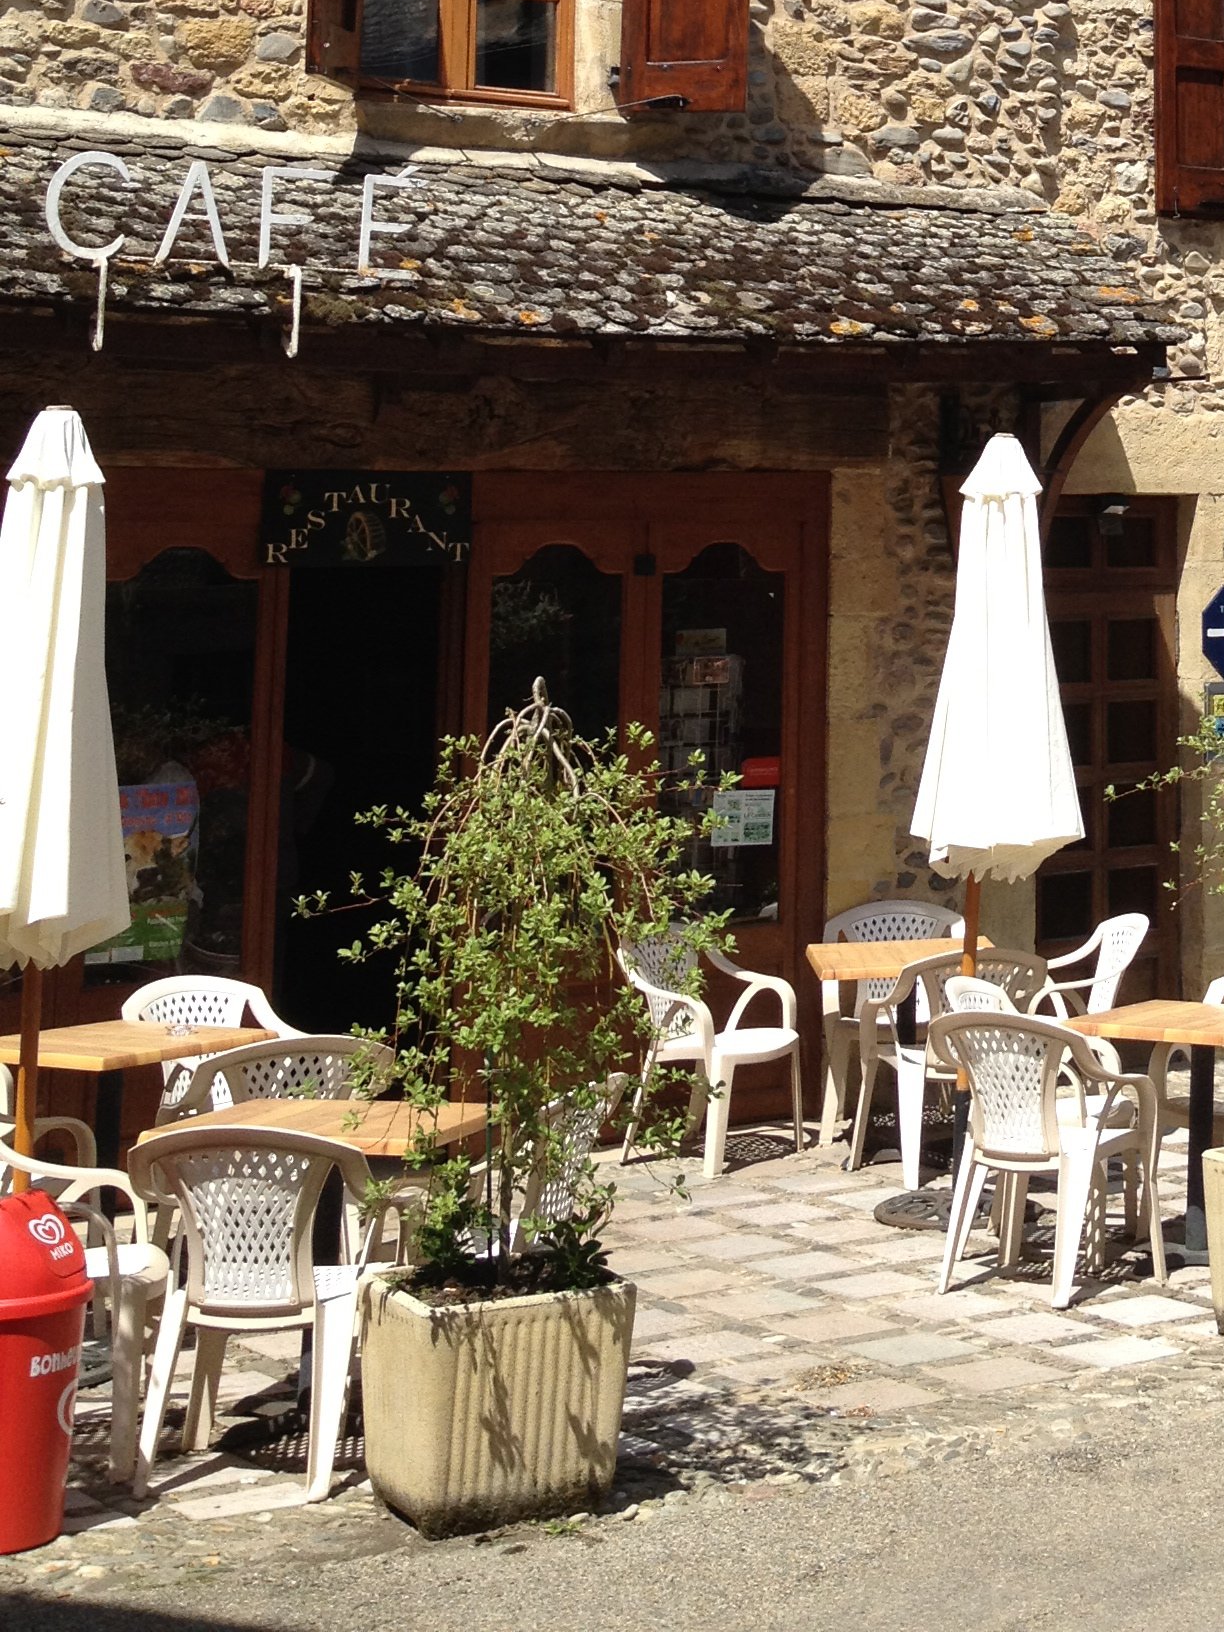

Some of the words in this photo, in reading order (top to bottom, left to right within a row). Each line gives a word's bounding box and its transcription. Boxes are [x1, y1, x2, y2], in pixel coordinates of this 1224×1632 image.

[44, 150, 428, 280] CAFÉ
[265, 482, 470, 564] RESTAURANT
[50, 1243, 74, 1261] MIKO
